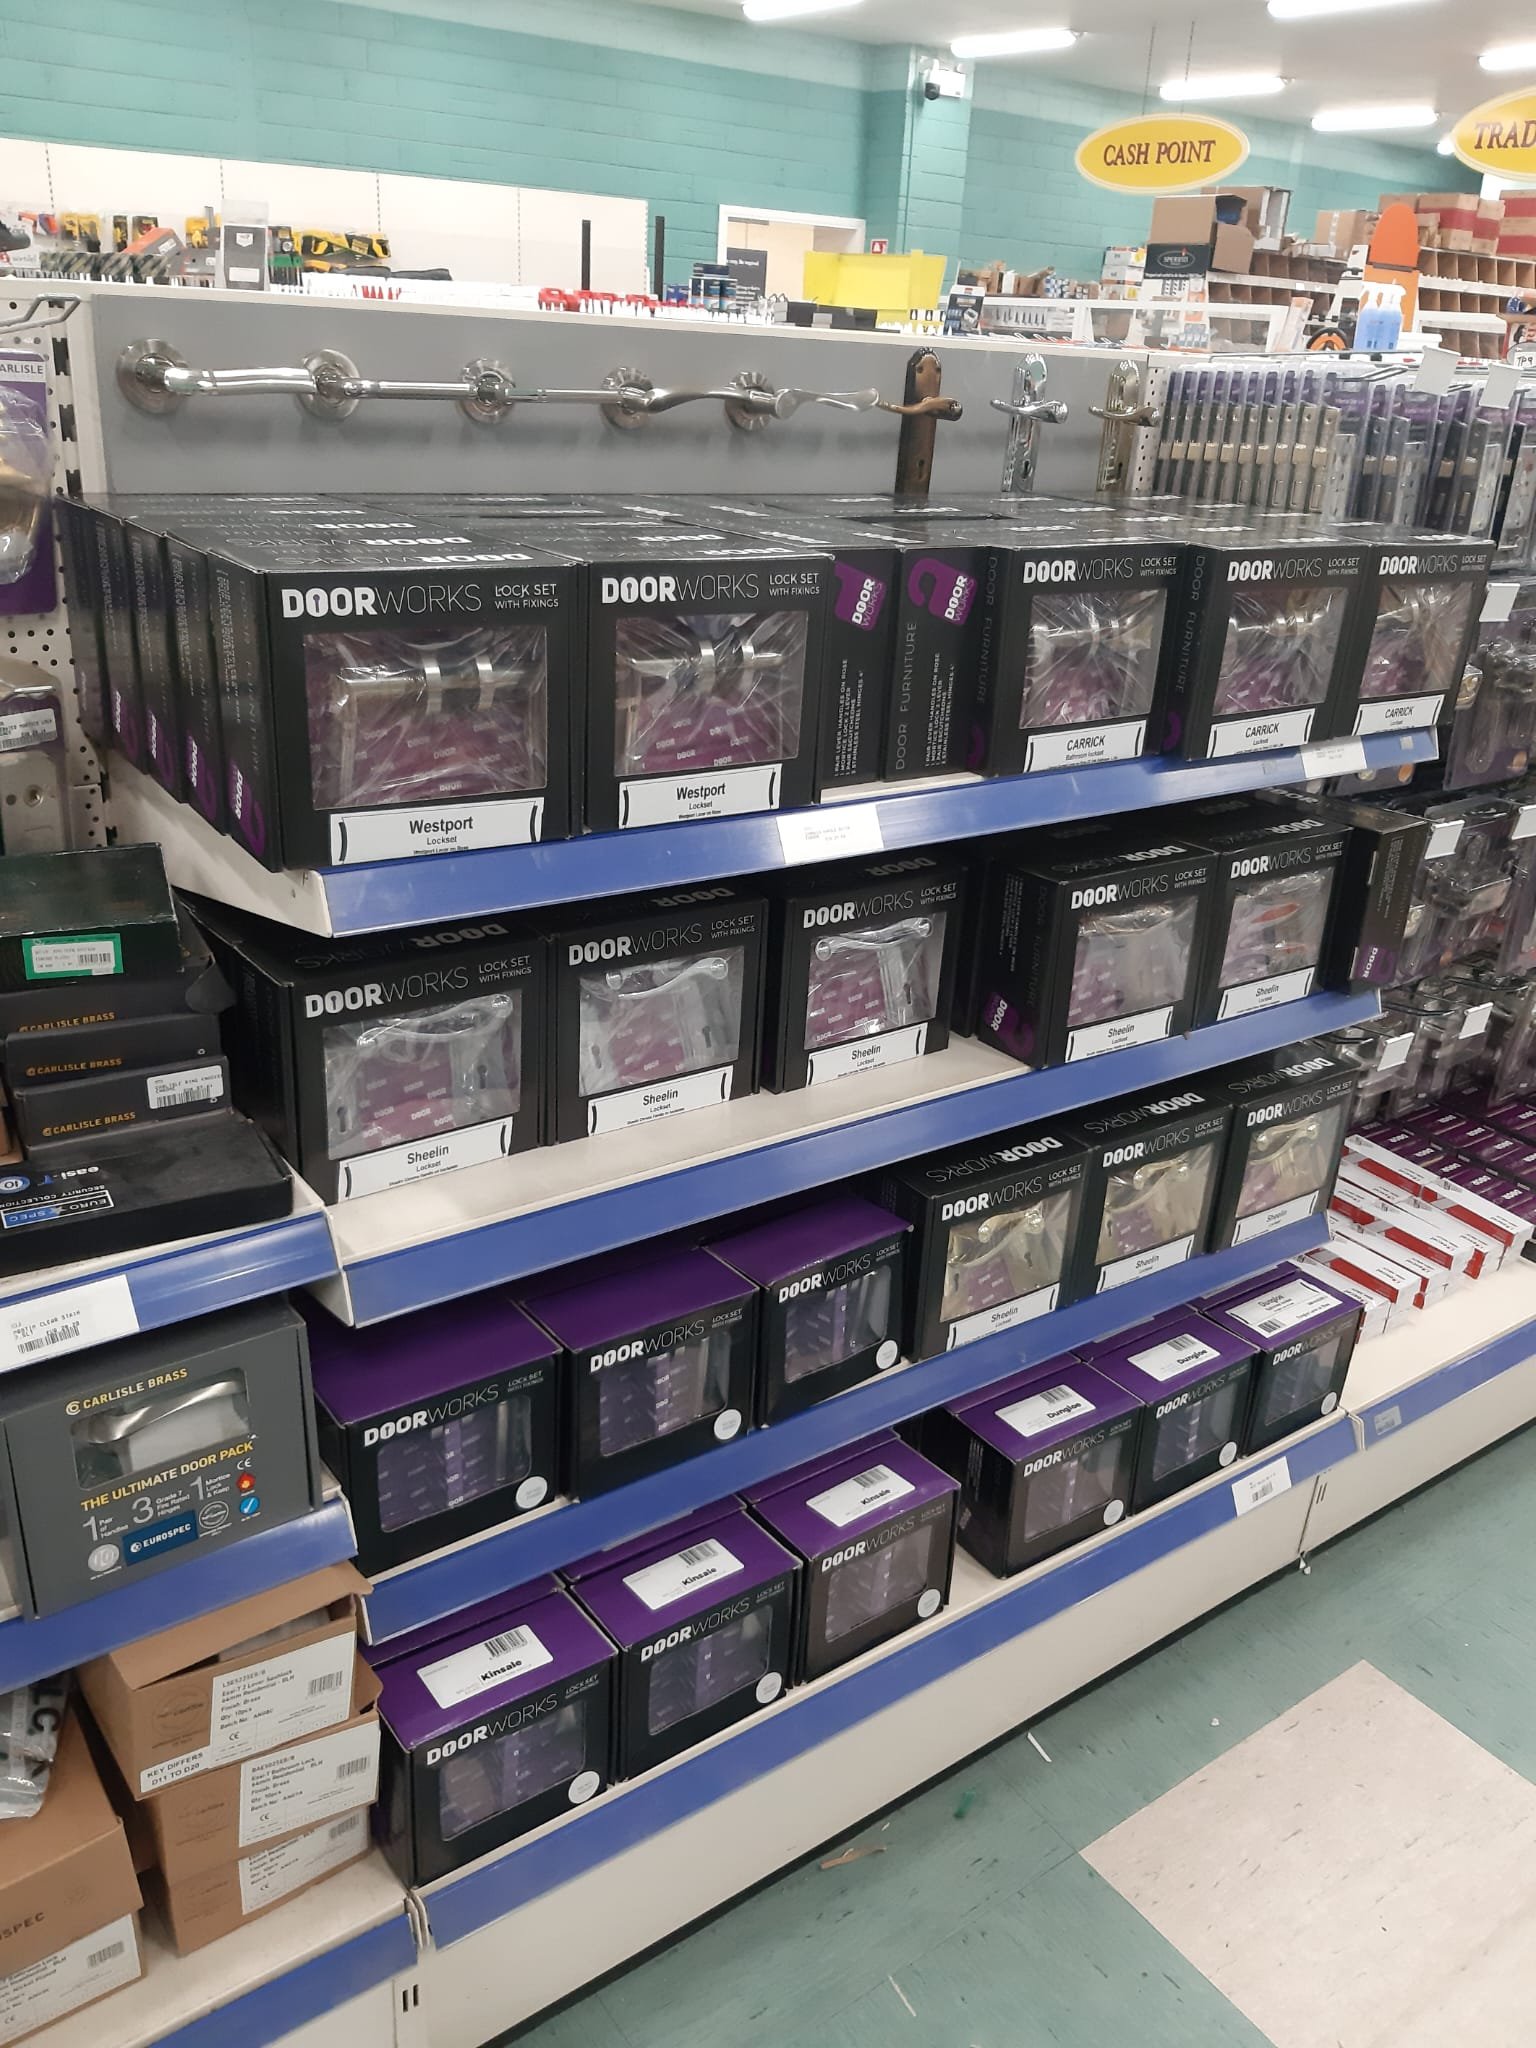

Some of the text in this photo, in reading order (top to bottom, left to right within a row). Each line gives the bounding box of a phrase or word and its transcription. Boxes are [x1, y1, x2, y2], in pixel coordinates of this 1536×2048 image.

[1103, 140, 1216, 166] CASH POINT
[1023, 557, 1177, 584] DOORWORKS LOCK SET
[1227, 557, 1360, 582] DOORWORKS LOCK SET
[1378, 554, 1458, 576] DOORWORKS
[1462, 555, 1475, 564] LOCK
[1476, 554, 1487, 563] SET
[281, 584, 557, 618] DOORWORKS LOCK SET
[602, 573, 819, 604] DOORWORKS LOCK SET
[769, 586, 820, 595] WITH FIXINGS
[851, 578, 875, 625] DOOR
[944, 575, 968, 620] DOOR
[495, 599, 559, 610] WITH FIXINGS
[896, 623, 917, 770] DOOR FURNITURE
[1385, 706, 1413, 719] CARRICK
[1066, 735, 1106, 751] CARRICK
[1245, 722, 1280, 738] CARRICK
[234, 769, 243, 820] DOOR
[676, 783, 726, 801] Westport
[689, 800, 713, 810] Lockset
[409, 816, 473, 835] Westport
[427, 836, 457, 846] Lockset
[1230, 847, 1312, 879] DOORWORKS
[1071, 868, 1208, 910] DOORWORKS LOCK SET
[803, 882, 957, 929] DOORWORKS LOCK SET
[568, 915, 755, 966] DOORWORKS LOCK SET
[479, 967, 532, 984] WITH FIXINGS
[1362, 947, 1378, 979] DOOR
[305, 955, 531, 1019] DOORWORKS LOCK SET
[83, 1012, 115, 1025] BRASS
[990, 999, 1008, 1031] DOOR
[1107, 1023, 1135, 1038] Sheelin
[851, 1044, 881, 1060] Sheelin
[37, 1058, 122, 1075] CARLISLE BRASS
[642, 1089, 679, 1106] Sheelin
[1247, 1090, 1323, 1127] DOORWORKS
[53, 1112, 137, 1135] CARLISLE BRASS
[1083, 1092, 1205, 1134] DOORWORKS
[407, 1145, 449, 1165] Sheelin
[1103, 1127, 1190, 1168] DOORWORKS
[1195, 1121, 1211, 1132] LOCK
[1212, 1117, 1225, 1127] SET
[416, 1160, 442, 1172] Lockset
[926, 1136, 1064, 1183] DOORWORKS
[61, 1185, 105, 1200] SECURITY
[941, 1164, 1082, 1222] DOORWORKS LOCK SET
[9, 1199, 107, 1222] EURO SPEC
[778, 1253, 871, 1304] DOORWORKS
[991, 1306, 1019, 1323] Sheelin
[590, 1319, 705, 1374] DOORWORKS
[712, 1313, 728, 1323] LOCK
[730, 1309, 743, 1318] SET
[1176, 1349, 1208, 1365] Dungloe
[83, 1368, 188, 1410] CARLISLE BRASS
[1155, 1375, 1226, 1420] DOORWORKS
[364, 1370, 543, 1448] DOORWORKS LOCK SET
[1046, 1402, 1082, 1419] Dungloe
[1023, 1430, 1105, 1477] DOORWORKS
[80, 1440, 254, 1512] THE ULTIMATE DOOR PACK
[190, 1475, 204, 1501] 1
[205, 1473, 232, 1485] Mortice
[156, 1494, 176, 1504] Grade
[860, 1488, 891, 1506] Kinsale
[131, 1497, 154, 1524] 3
[82, 1515, 98, 1542] 1
[143, 1523, 192, 1547] EUROSPEC
[822, 1516, 915, 1573] DOORWORKS
[682, 1567, 718, 1586] Kinsale
[640, 1597, 750, 1662] DOORWORKS
[480, 1659, 523, 1681] Kinsale
[426, 1693, 558, 1766] DOORWORKS
[147, 1752, 203, 1779] KEY DIFFERS
[151, 1763, 201, 1786] D11 TO D20
[0, 1911, 45, 1940] SPEC
